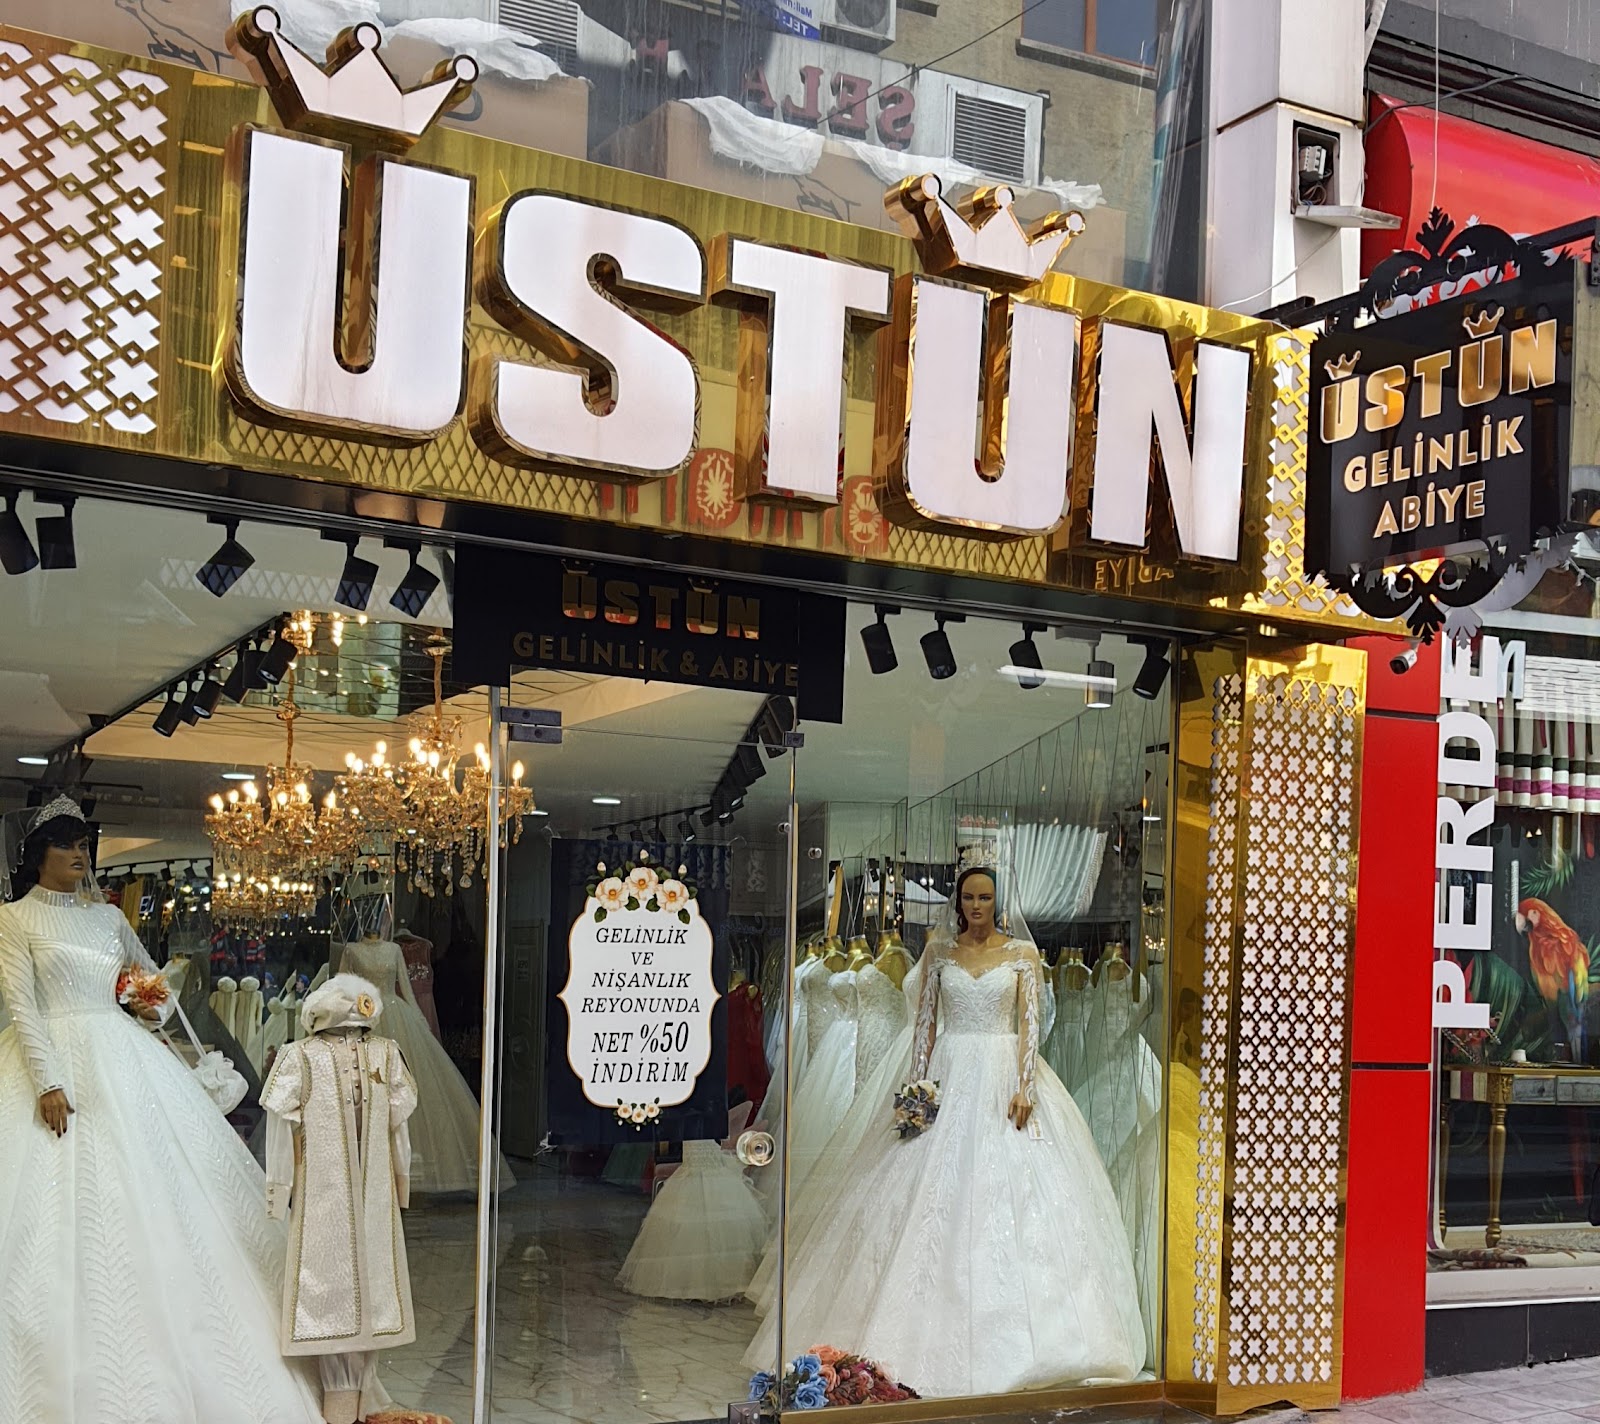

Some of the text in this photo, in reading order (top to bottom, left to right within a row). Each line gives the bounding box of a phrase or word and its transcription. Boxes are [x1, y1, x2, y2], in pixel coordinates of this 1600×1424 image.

[228, 6, 1254, 562] ÜSTÜN
[1320, 306, 1558, 444] ÜSTÜN
[1343, 414, 1525, 493] GELİNLİK
[1372, 479, 1487, 538] ABİYE
[561, 558, 761, 640] ÜSTÜN
[512, 631, 799, 688] GELİNLİK & ABİYE
[1432, 634, 1500, 1029] PERDE
[595, 924, 689, 945] GELİNLİK
[630, 951, 655, 966] VE
[581, 997, 701, 1013] REYONUNDA
[591, 968, 692, 991] NİŞANLIK
[591, 1021, 690, 1054] NET %50
[590, 1057, 690, 1083] İNDİRİM
